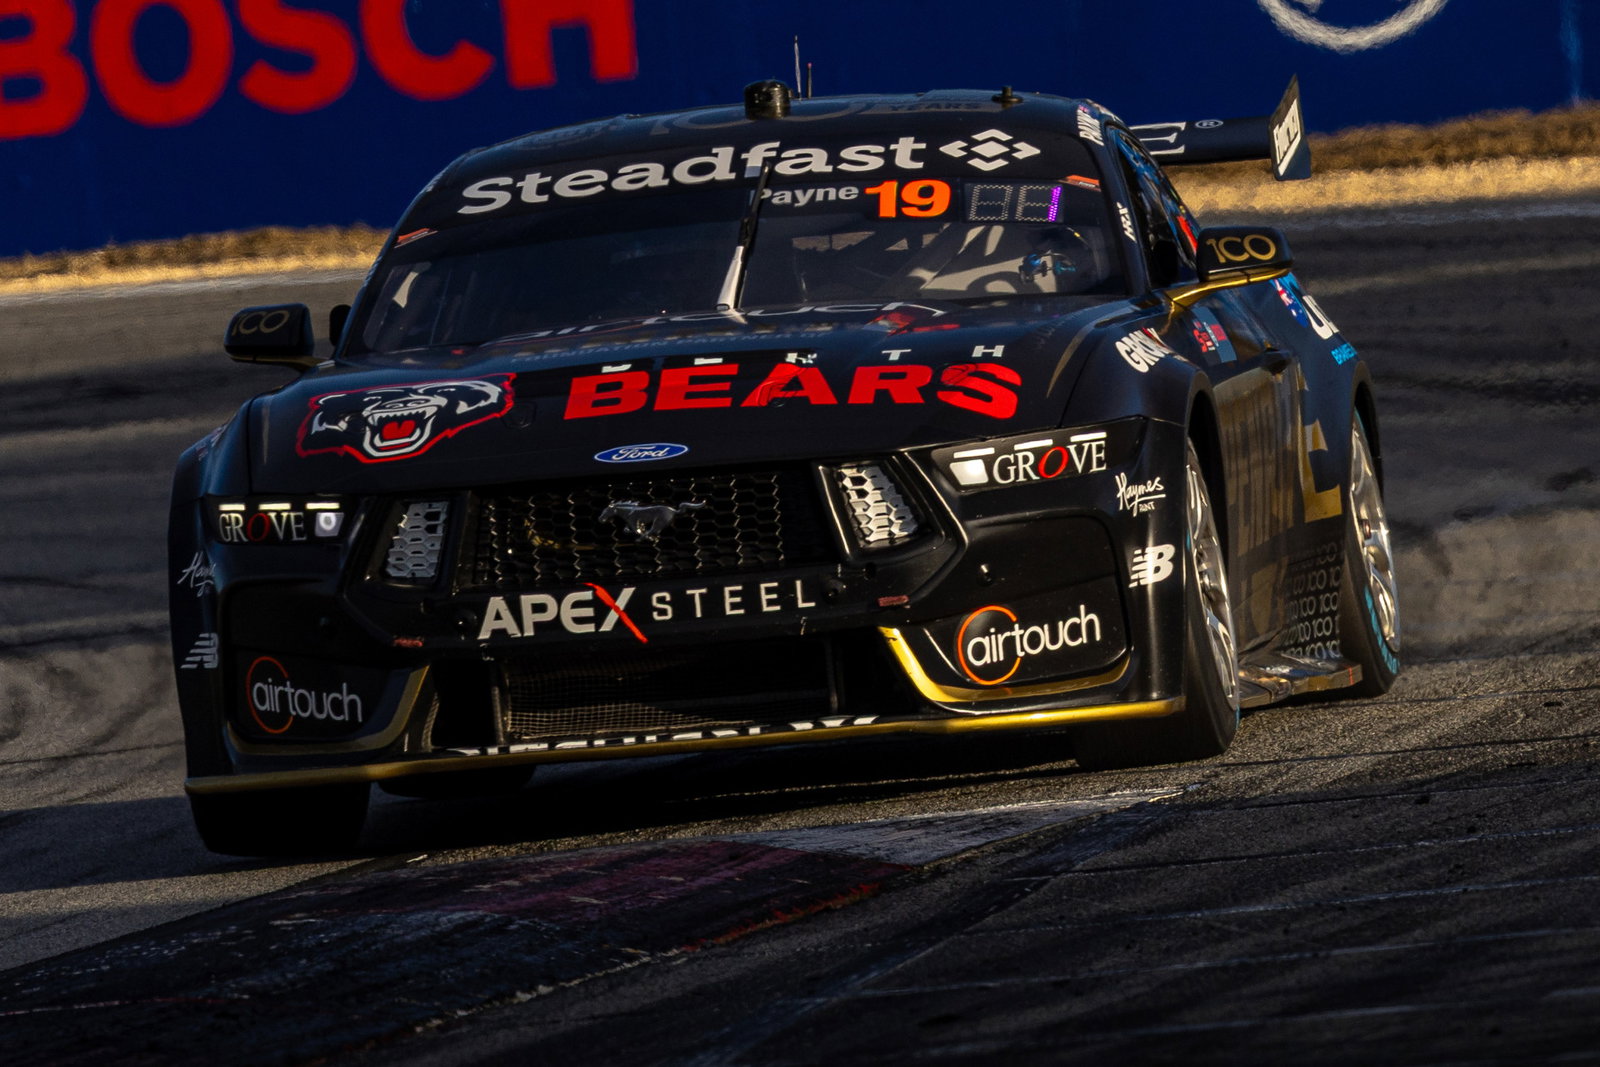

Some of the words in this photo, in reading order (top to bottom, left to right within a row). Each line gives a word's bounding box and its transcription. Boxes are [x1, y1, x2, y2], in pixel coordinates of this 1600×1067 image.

[0, 0, 639, 141] BOSCH
[457, 136, 927, 215] Steadfast
[748, 186, 861, 208] Payne
[864, 178, 952, 218] 19
[1205, 233, 1276, 264] 100
[563, 363, 1023, 420] BEARS
[611, 446, 671, 461] Ford
[992, 440, 1107, 484] GROVE
[1115, 472, 1165, 518] Haymes
[218, 511, 308, 544] GROVE
[477, 583, 649, 643] APEX
[651, 580, 817, 622] STEEL
[966, 604, 1102, 668] airtouch
[252, 682, 364, 724] airtouch
